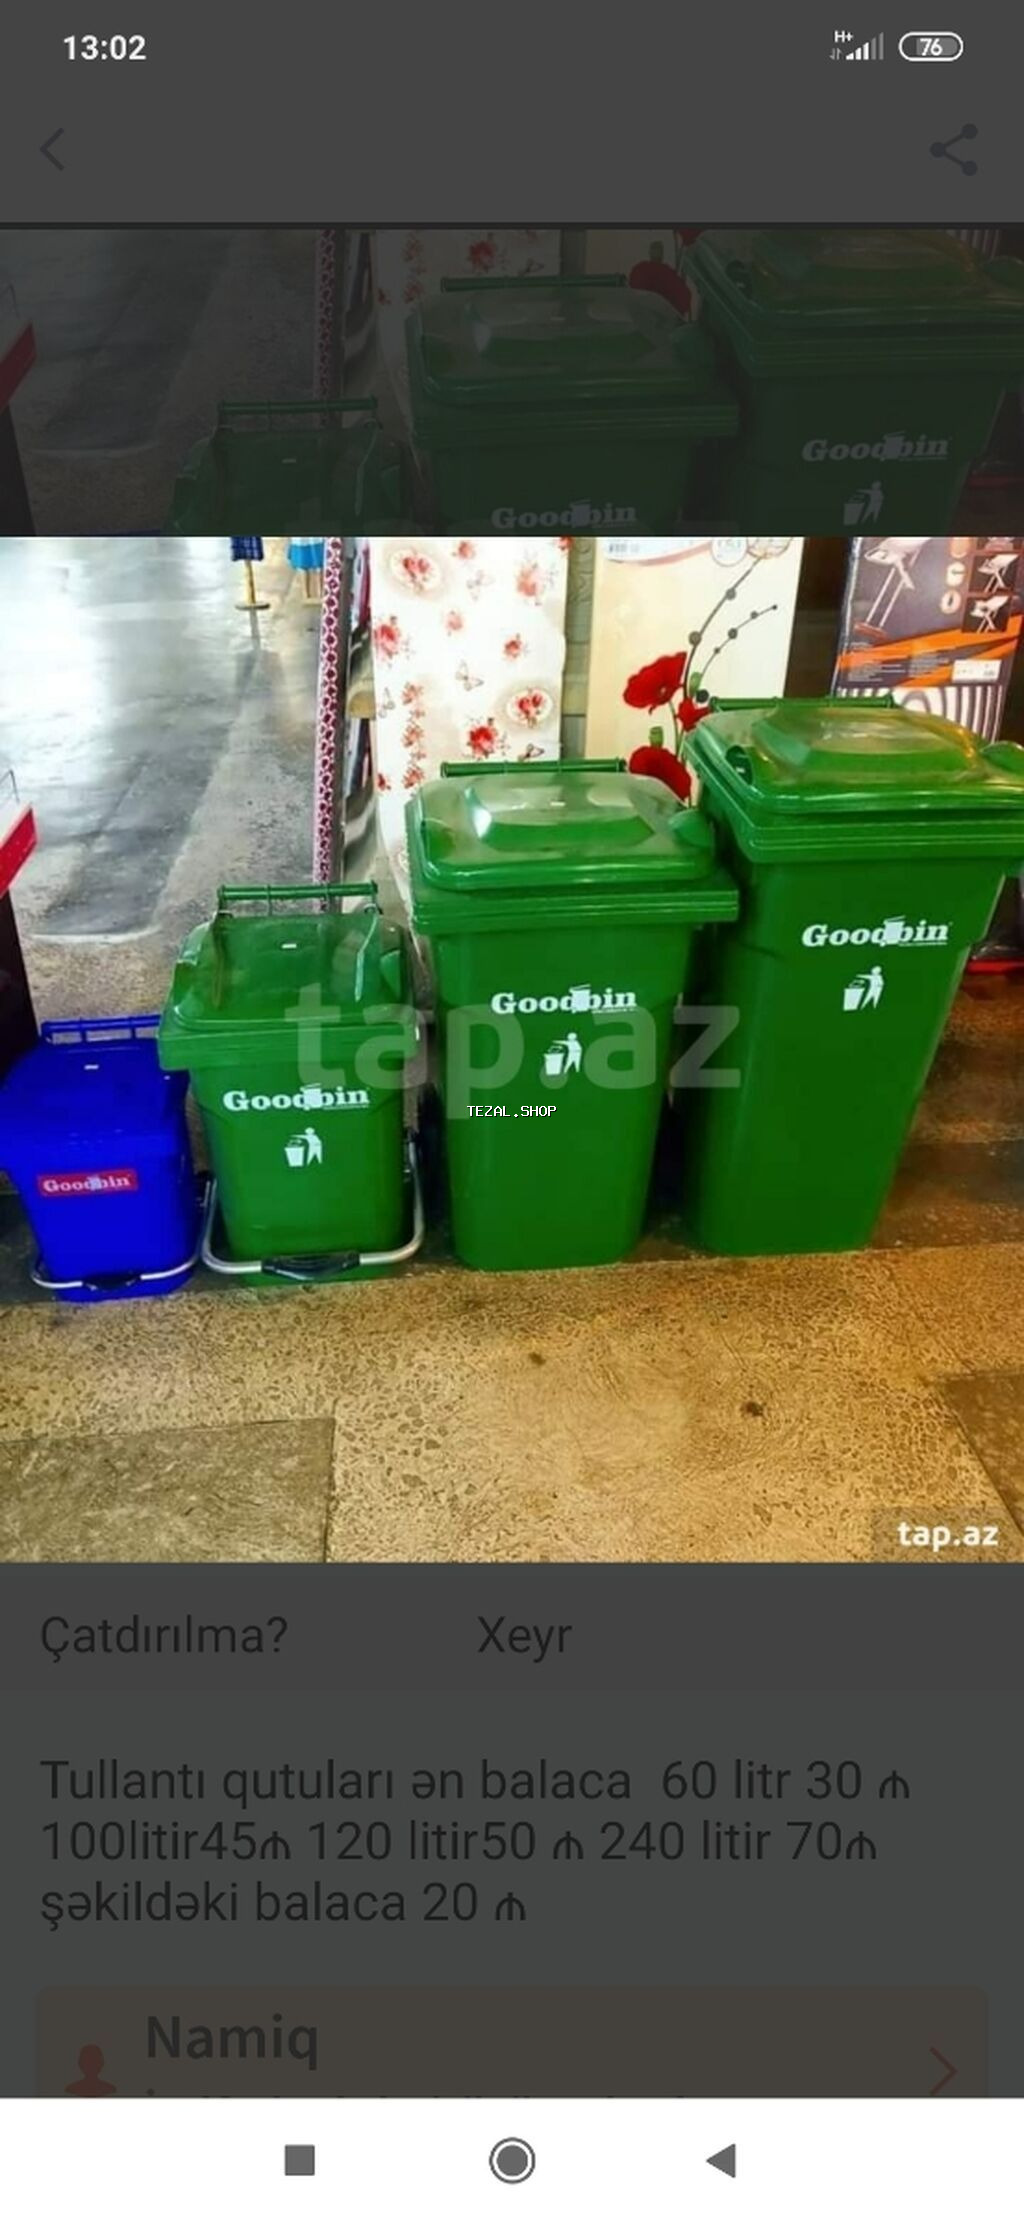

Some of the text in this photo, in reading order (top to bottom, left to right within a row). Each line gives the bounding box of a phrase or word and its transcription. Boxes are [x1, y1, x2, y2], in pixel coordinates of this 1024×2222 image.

[63, 34, 147, 61] 13:02
[833, 30, 854, 43] H+
[919, 38, 943, 57] 76
[40, 1613, 288, 1663] Çatdırılma?
[477, 1615, 573, 1663] Xeyr
[40, 1758, 205, 1800] Tullantı
[222, 1758, 393, 1808] qutuları
[411, 1769, 464, 1800] ən
[481, 1758, 631, 1801] balaca
[662, 1760, 717, 1800] 60
[734, 1758, 792, 1800] litr
[806, 1760, 862, 1801] 30
[308, 1820, 392, 1861] 120
[410, 1819, 536, 1861] litir50
[599, 1820, 684, 1861] 240
[702, 1819, 772, 1861] litir
[40, 1880, 238, 1930] şəkildəki
[256, 1880, 406, 1922] balaca
[422, 1881, 478, 1922] 20
[146, 2012, 319, 2071] Namiq
